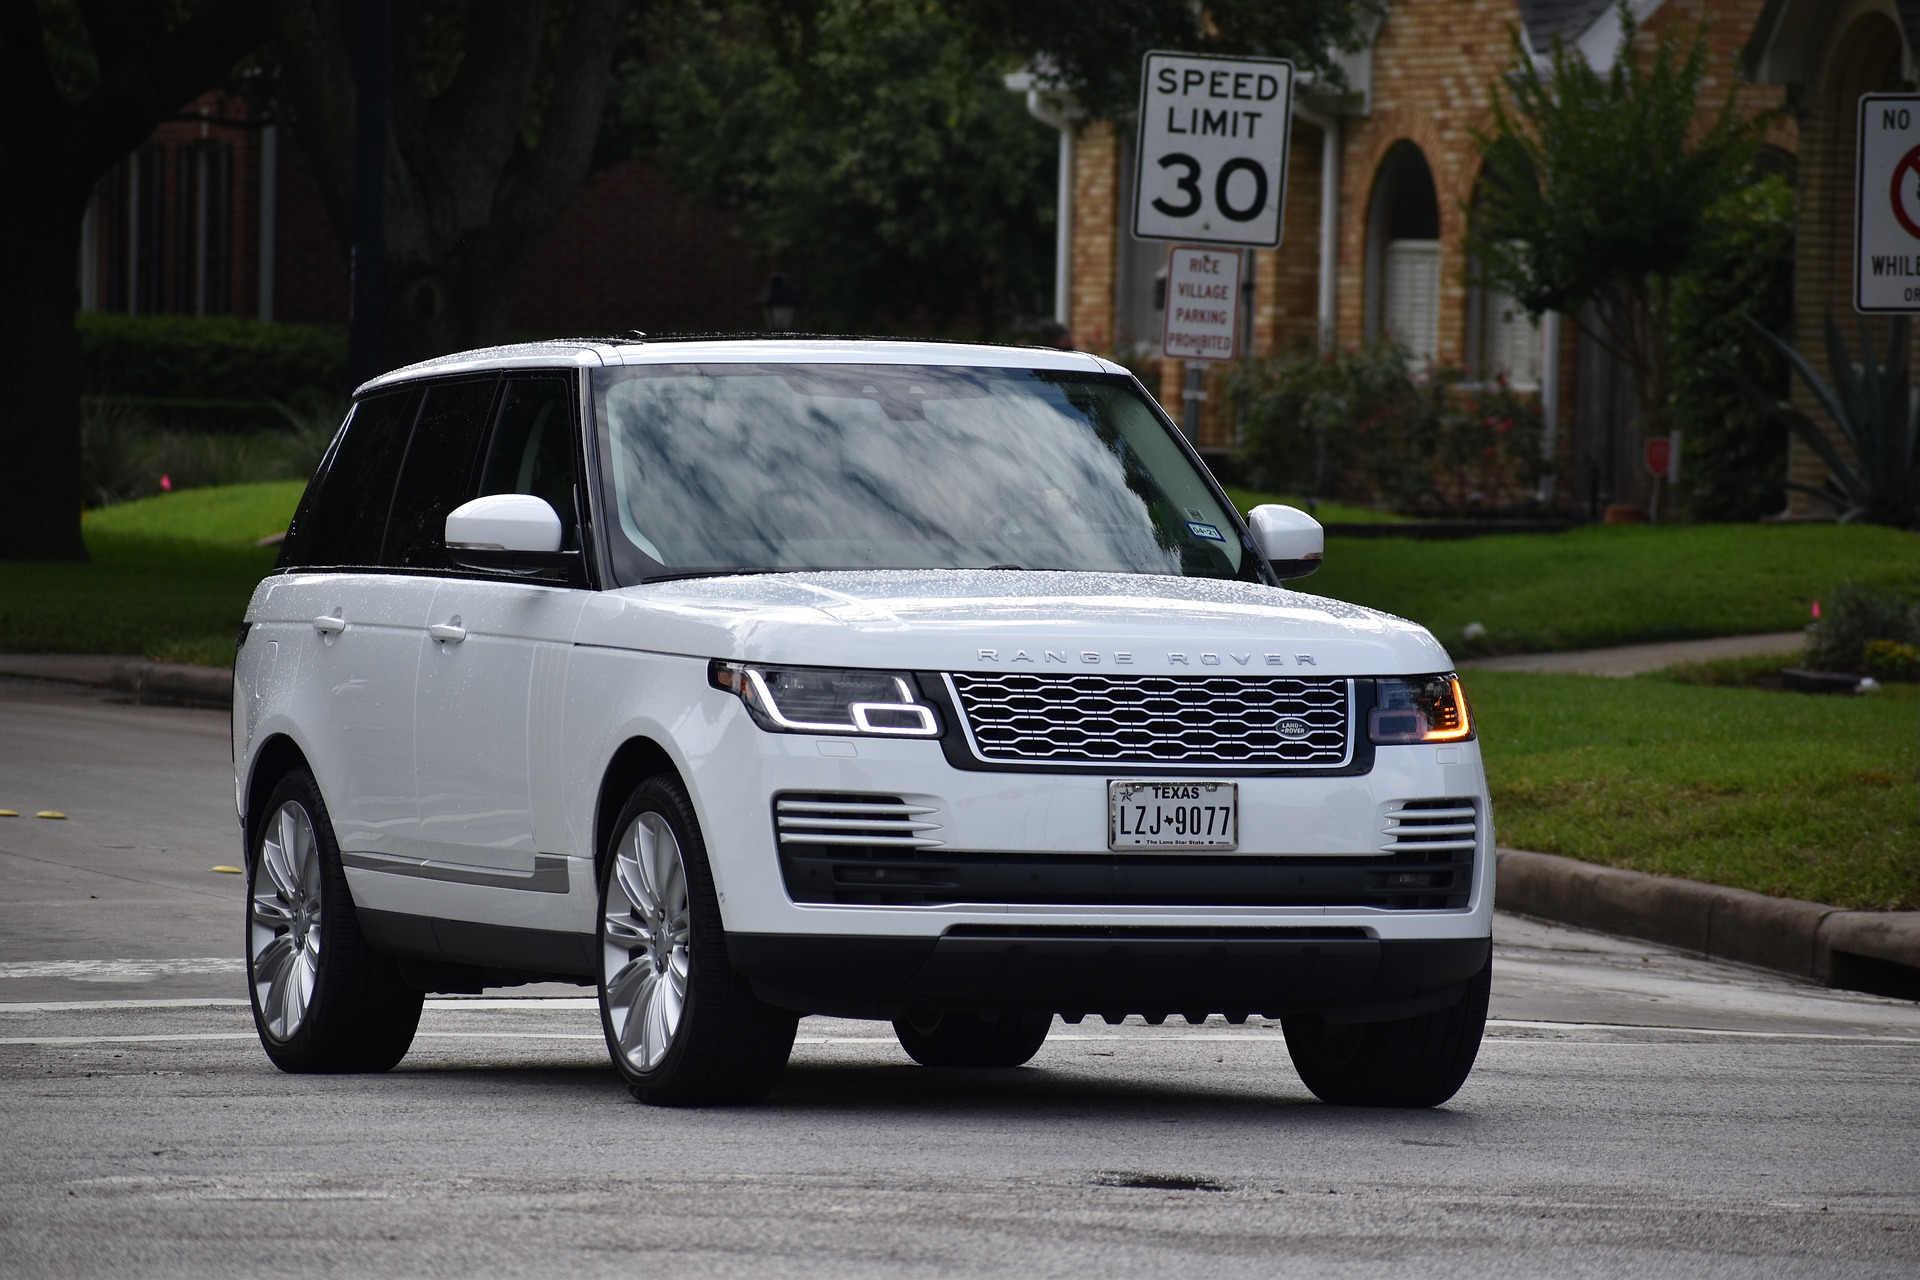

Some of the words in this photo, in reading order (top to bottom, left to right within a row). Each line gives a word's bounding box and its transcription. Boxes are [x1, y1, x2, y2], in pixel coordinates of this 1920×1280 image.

[1156, 68, 1279, 101] SPEED
[1167, 107, 1262, 139] LIMIT
[1882, 109, 1911, 130] NO
[1151, 153, 1268, 222] 30
[1189, 258, 1221, 275] RICE
[1178, 282, 1229, 300] VILLAGE
[1175, 308, 1227, 325] PARKING
[1167, 332, 1231, 351] PROHIBITED
[976, 649, 1135, 665] RANGE
[1166, 651, 1318, 667] ROVER
[1152, 786, 1200, 799] TEXAS
